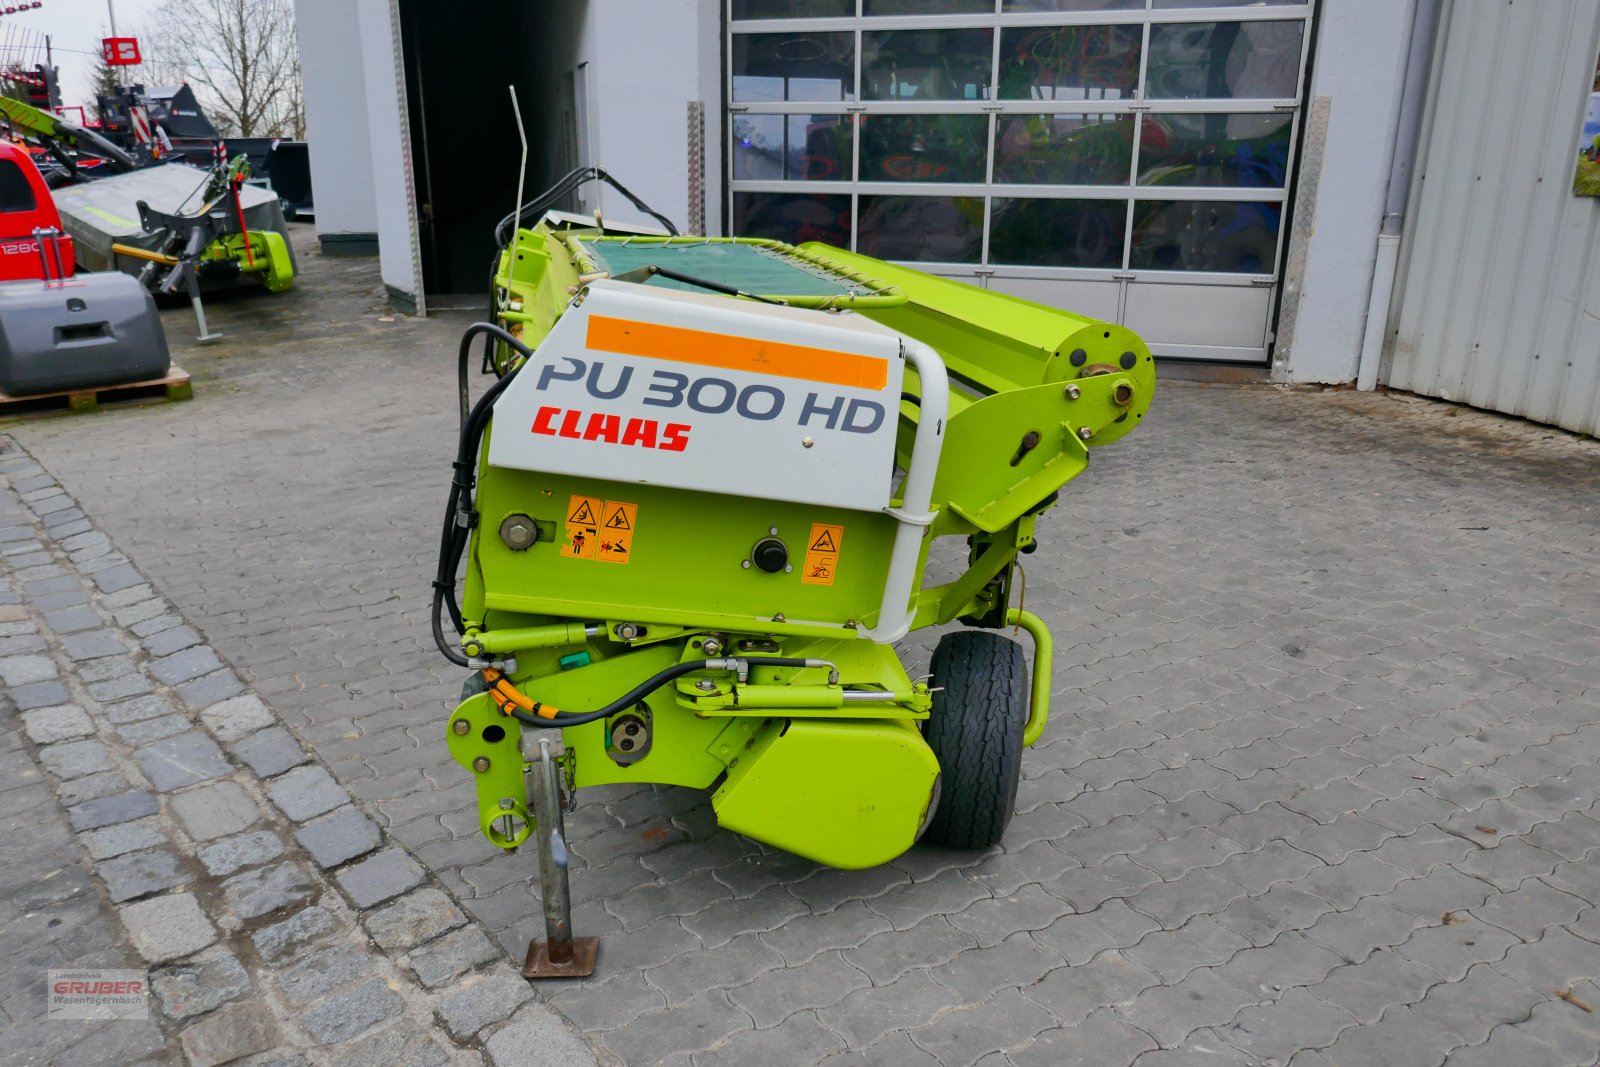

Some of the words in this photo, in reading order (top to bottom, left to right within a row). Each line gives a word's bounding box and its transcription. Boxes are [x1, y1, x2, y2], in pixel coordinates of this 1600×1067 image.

[1, 242, 40, 255] 1280
[535, 357, 635, 400] PU
[642, 369, 786, 421] 300
[797, 392, 886, 434] HD
[531, 406, 692, 452] CLAAS
